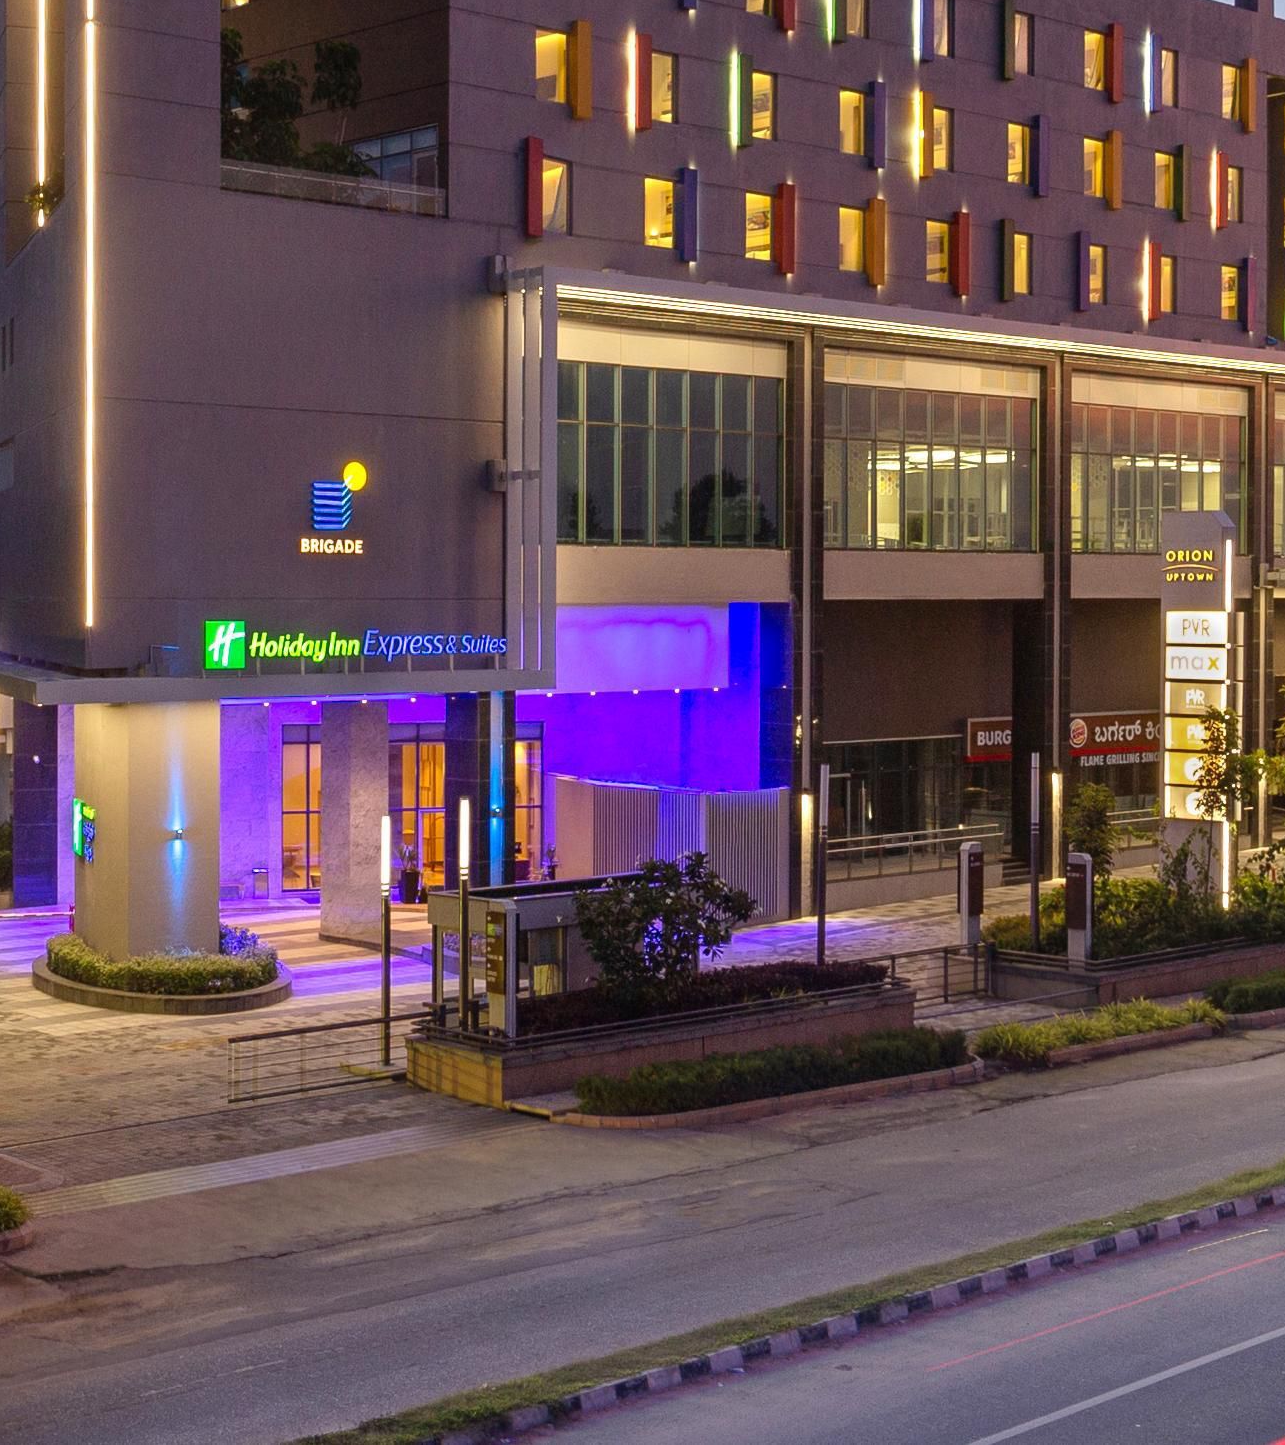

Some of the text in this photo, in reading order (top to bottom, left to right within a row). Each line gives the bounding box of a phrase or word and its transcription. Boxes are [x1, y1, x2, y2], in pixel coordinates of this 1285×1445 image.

[300, 538, 364, 554] BRIGADE
[1165, 550, 1213, 562] ORION
[1165, 572, 1214, 582] UPTOWN
[1182, 618, 1210, 636] PVR
[249, 629, 507, 662] Holiday Inn Express & Suites
[1170, 655, 1219, 671] max
[1080, 754, 1104, 767] FLAME
[1106, 752, 1140, 765] GRILLING
